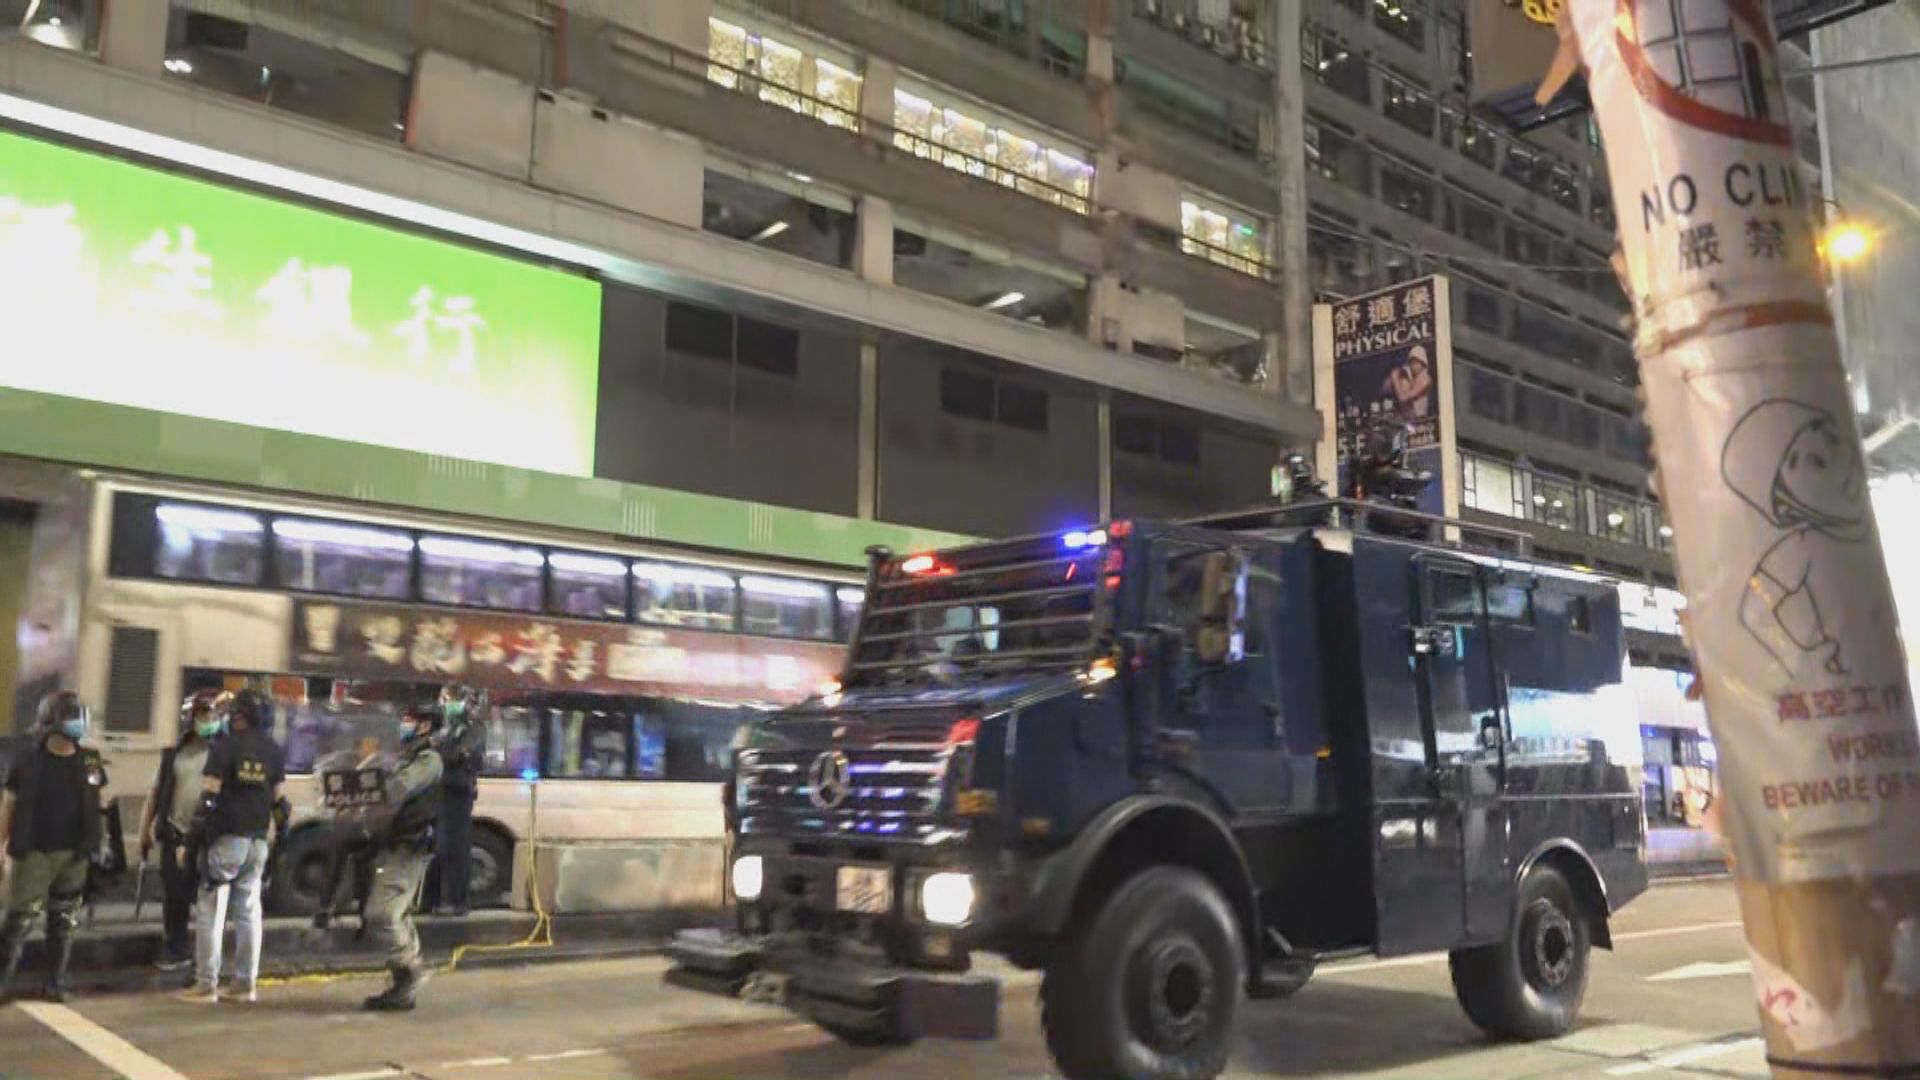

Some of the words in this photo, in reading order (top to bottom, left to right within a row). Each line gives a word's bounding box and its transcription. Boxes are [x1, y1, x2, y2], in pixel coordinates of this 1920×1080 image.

[1640, 172, 1698, 232] NO
[1335, 286, 1432, 335] 舒適堡
[1335, 321, 1432, 359] PHYSICAL
[1762, 774, 1869, 809] BEWARE
